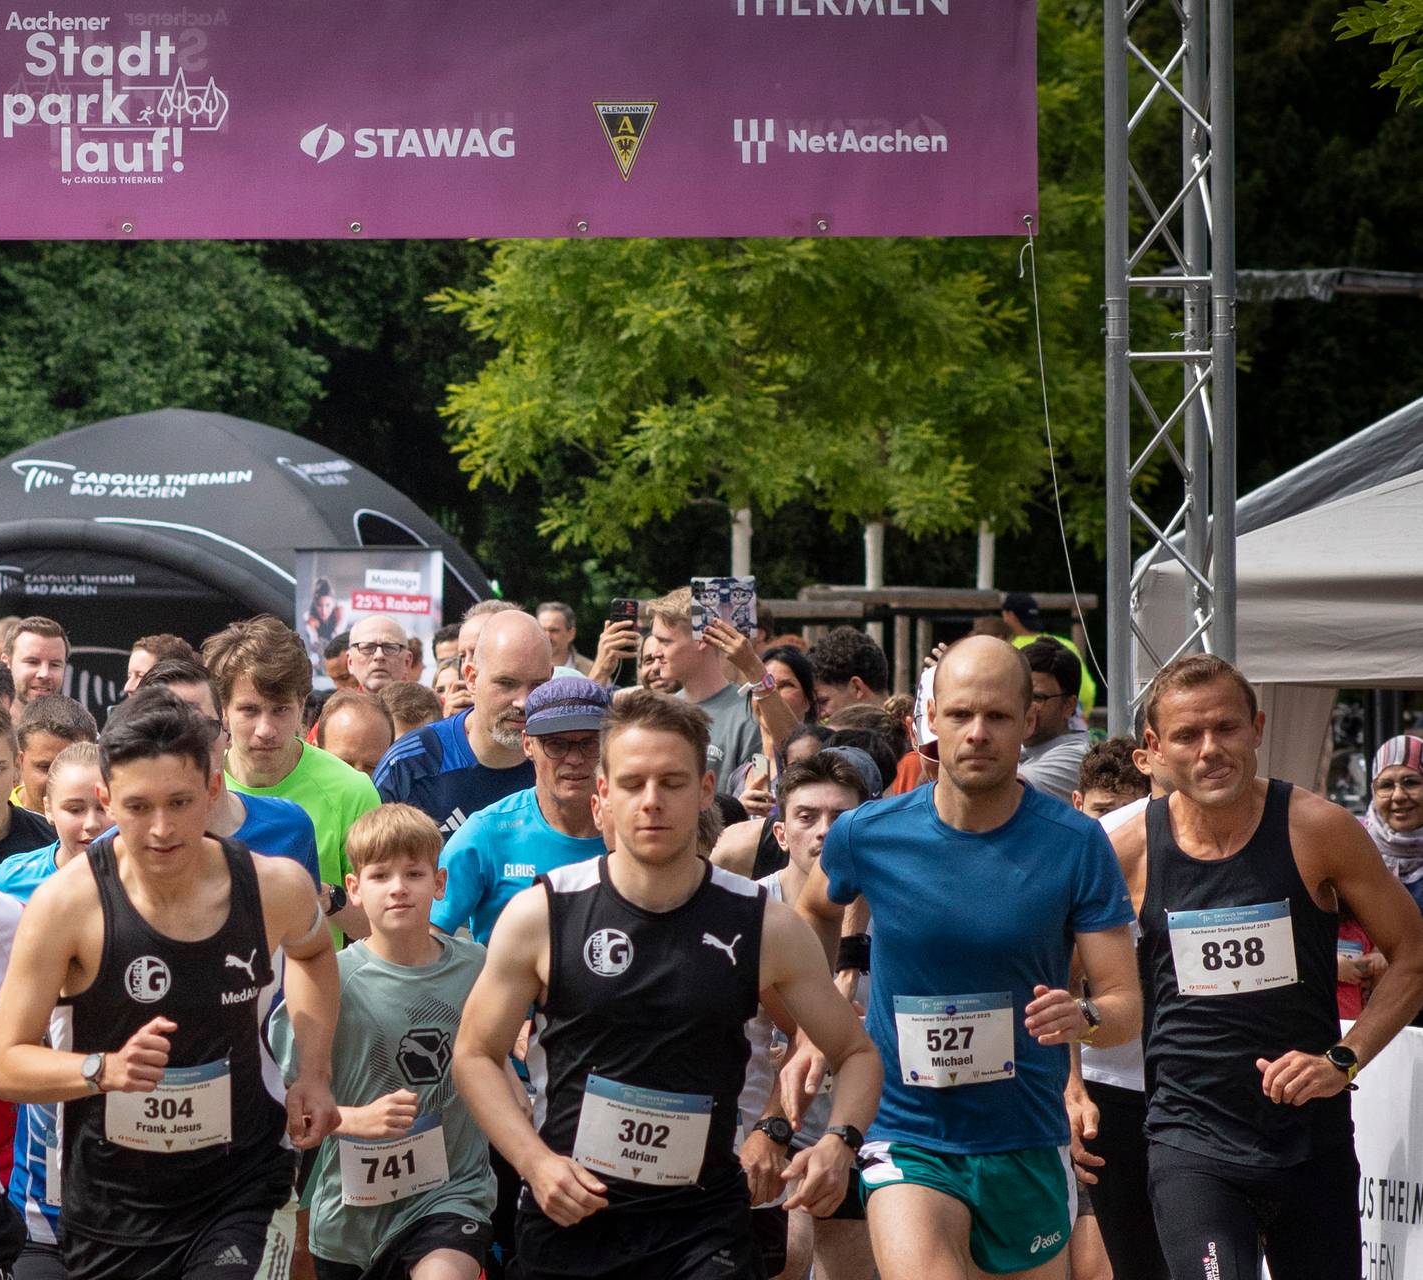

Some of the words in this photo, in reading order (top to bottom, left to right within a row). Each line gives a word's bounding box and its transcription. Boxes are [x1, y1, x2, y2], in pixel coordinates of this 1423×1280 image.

[5, 11, 110, 31] Aachener
[25, 30, 176, 77] Stadt
[3, 79, 131, 138] park
[601, 105, 651, 113] ALEMANNIA
[617, 116, 635, 134] A
[61, 127, 184, 172] lauf!
[354, 128, 515, 157] STAWAG
[788, 129, 948, 153] NetAachen
[62, 176, 72, 186] by
[72, 471, 160, 486] CAROLUS
[165, 470, 253, 486] THERMEN
[69, 484, 115, 497] BAD
[118, 486, 187, 499] AACHEN
[24, 575, 77, 584] CAROLUS
[80, 574, 135, 584] THERMEN
[371, 575, 417, 588] Montags
[25, 585, 48, 595] BAD
[49, 584, 97, 595] AACHEN
[355, 594, 384, 609] 25%
[385, 597, 429, 611] Rabatt
[1201, 936, 1266, 971] 838
[926, 1026, 975, 1052] 527
[931, 1054, 974, 1067] Michael
[144, 1097, 194, 1119] 304
[136, 1121, 167, 1134] Frank
[170, 1122, 202, 1134] Jesus
[617, 1119, 671, 1149] 302
[621, 1147, 658, 1164] Adrian
[360, 1148, 416, 1184] 741
